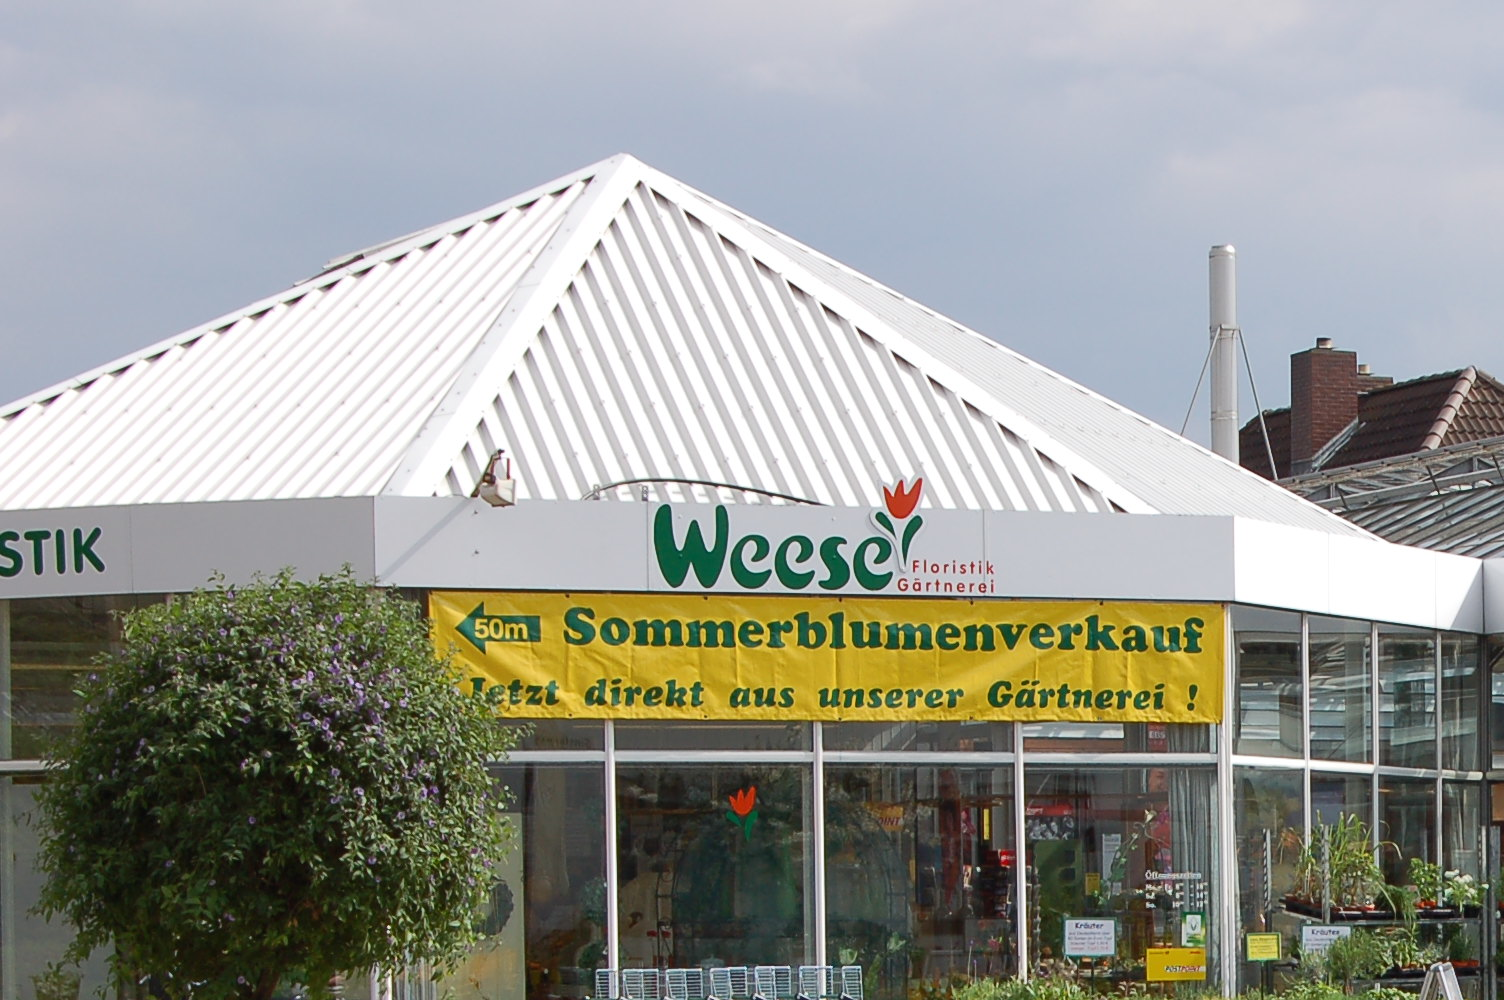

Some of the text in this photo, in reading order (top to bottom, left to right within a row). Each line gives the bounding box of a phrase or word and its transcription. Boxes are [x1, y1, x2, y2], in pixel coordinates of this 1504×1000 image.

[0, 527, 105, 576] STIK
[652, 502, 894, 590] Weese
[911, 559, 995, 576] Floristik
[896, 578, 996, 594] Gärtnerei
[474, 618, 529, 640] 50m
[563, 606, 1205, 654] Sommerblumenverkauf
[584, 678, 705, 708] direkt
[729, 687, 795, 709] aus
[818, 688, 964, 709] unserer
[987, 679, 1165, 711] Gärtnerei
[1186, 684, 1198, 711] !
